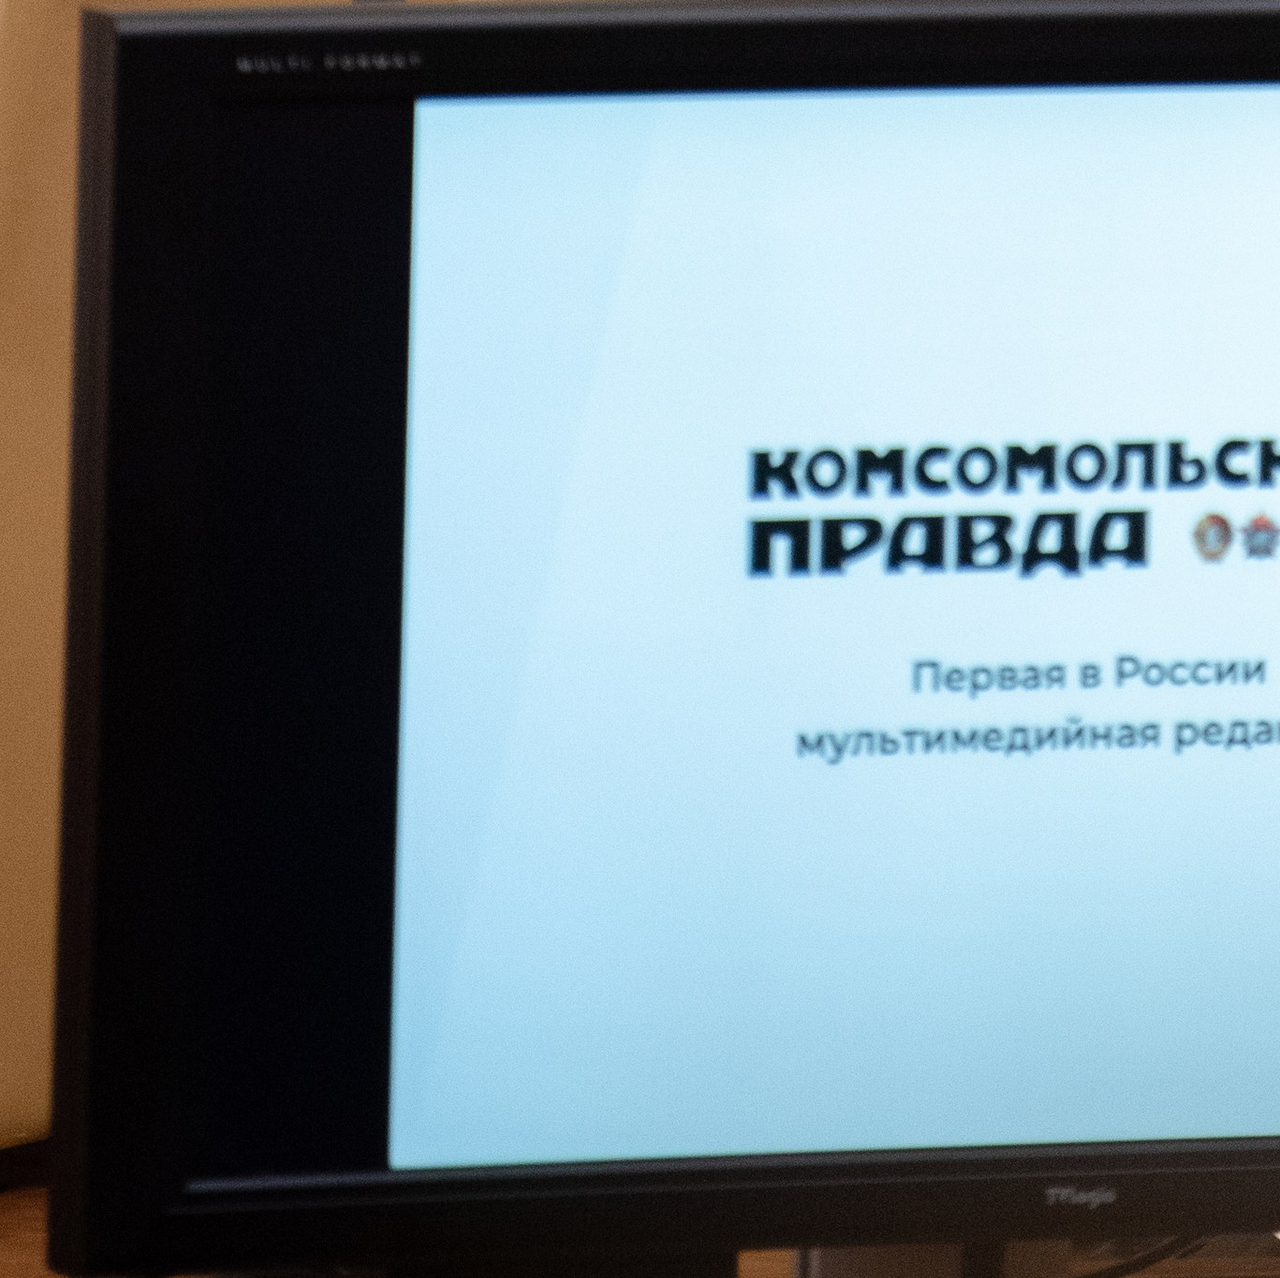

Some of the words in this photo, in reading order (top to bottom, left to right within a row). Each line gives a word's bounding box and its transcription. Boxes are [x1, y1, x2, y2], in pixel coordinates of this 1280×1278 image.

[747, 509, 1150, 578] ПРАВДА
[911, 656, 1066, 700] Первая
[1079, 660, 1104, 690] в
[1115, 653, 1268, 691] России
[795, 717, 1162, 766] мультимедийная
